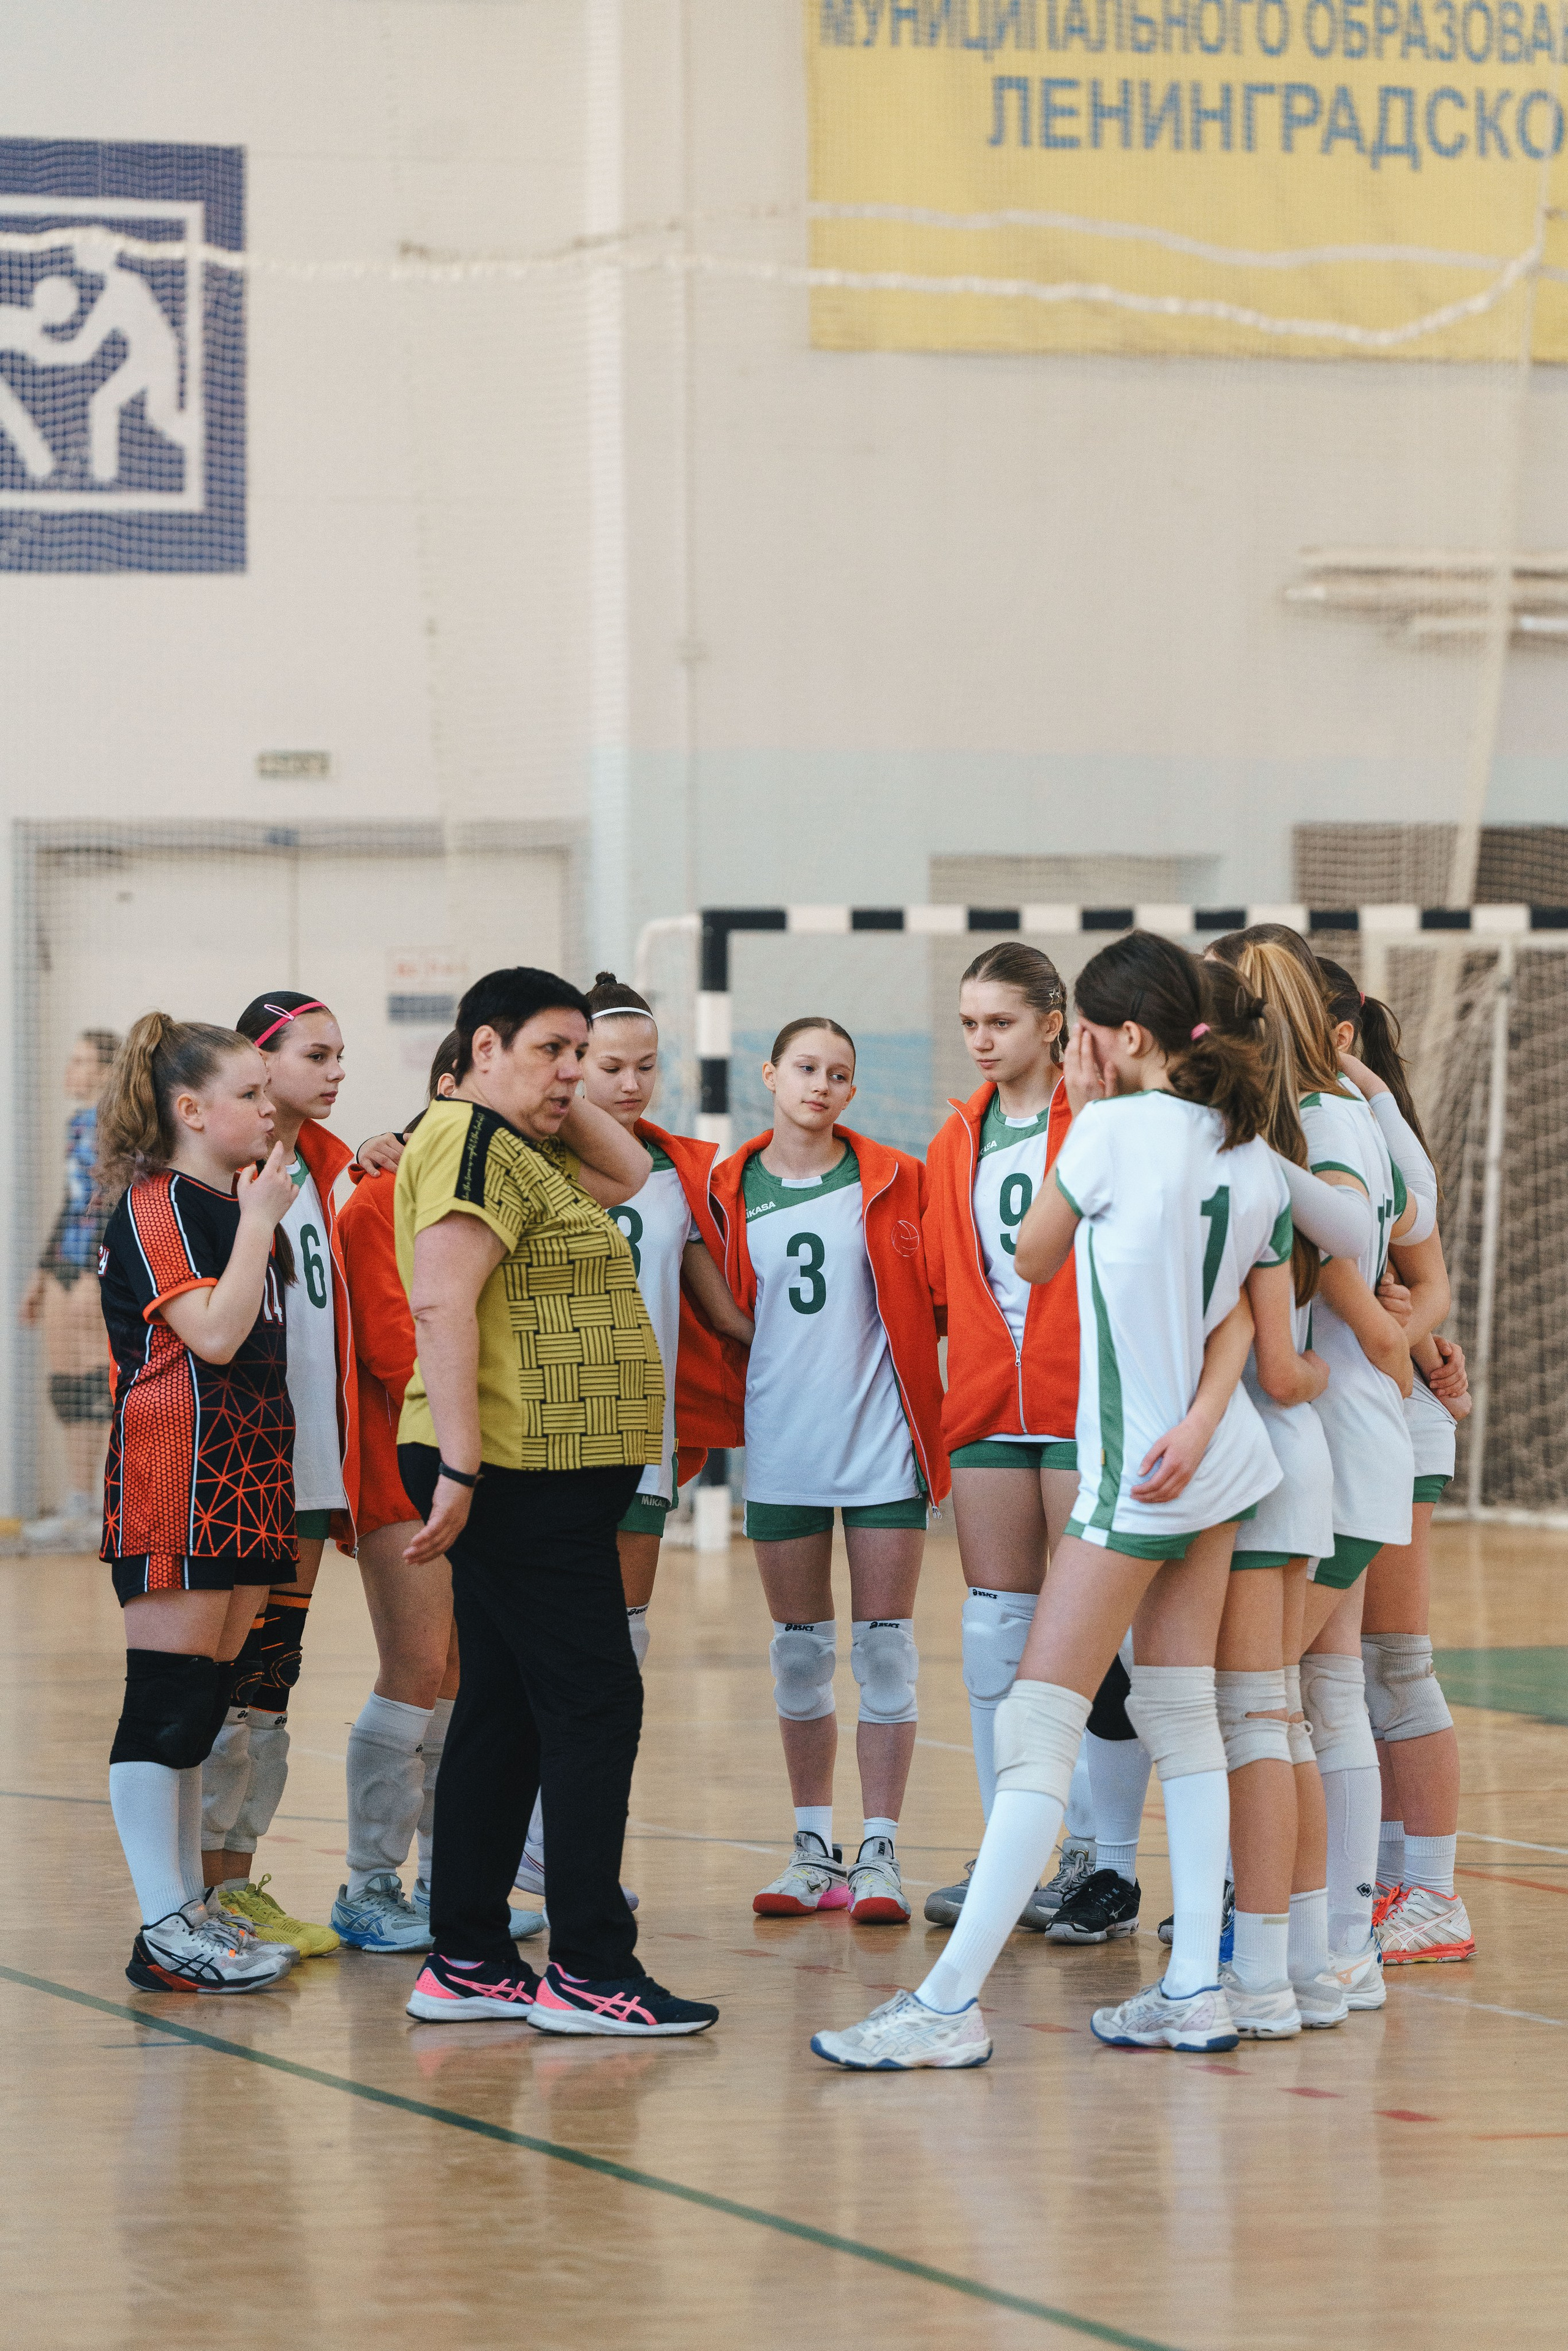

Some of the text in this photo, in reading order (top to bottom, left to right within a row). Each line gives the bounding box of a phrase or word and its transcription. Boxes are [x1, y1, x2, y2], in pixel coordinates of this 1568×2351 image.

[987, 75, 1564, 171] ЛЕНИНГРАДСКО
[1000, 1172, 1033, 1256] 9
[300, 1223, 327, 1309] 6
[786, 1232, 826, 1315] 3
[877, 1841, 886, 1855] NIKE
